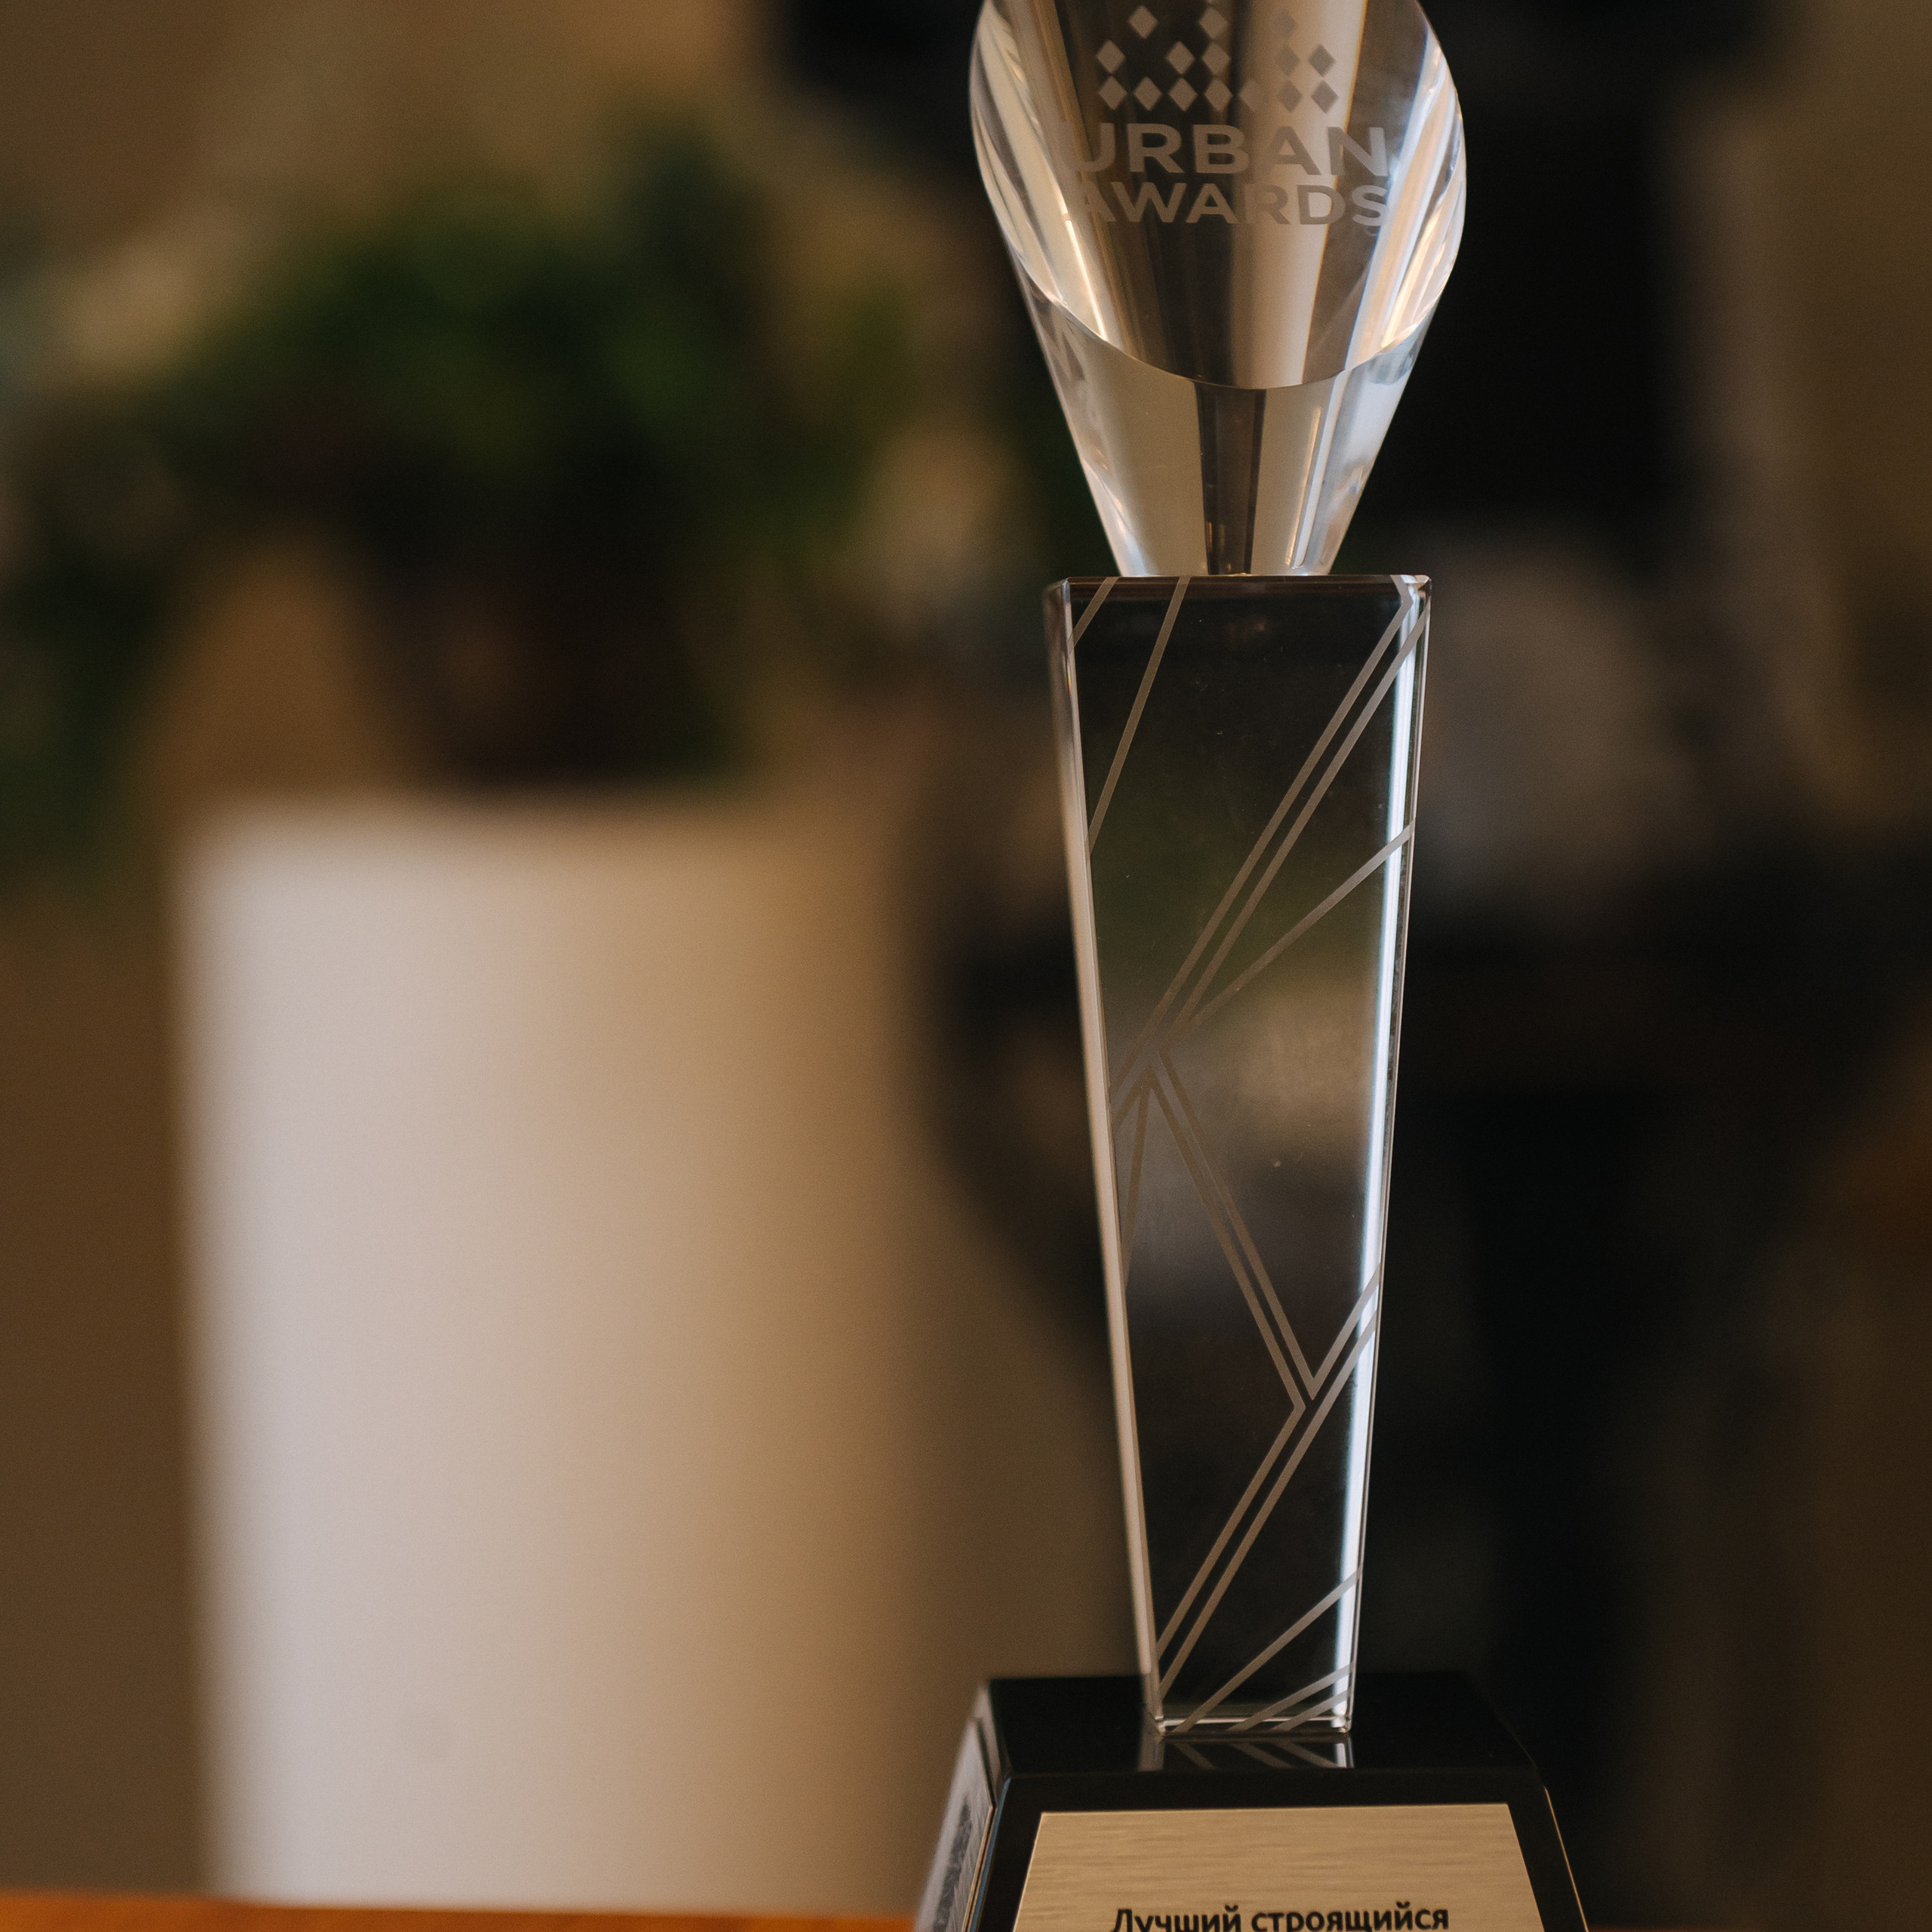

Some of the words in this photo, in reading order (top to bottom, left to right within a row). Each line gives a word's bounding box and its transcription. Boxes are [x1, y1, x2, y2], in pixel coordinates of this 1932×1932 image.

[1064, 123, 1389, 177] URBAN
[1112, 1905, 1242, 1932] Лучший
[1251, 1901, 1449, 1932] строящийся
